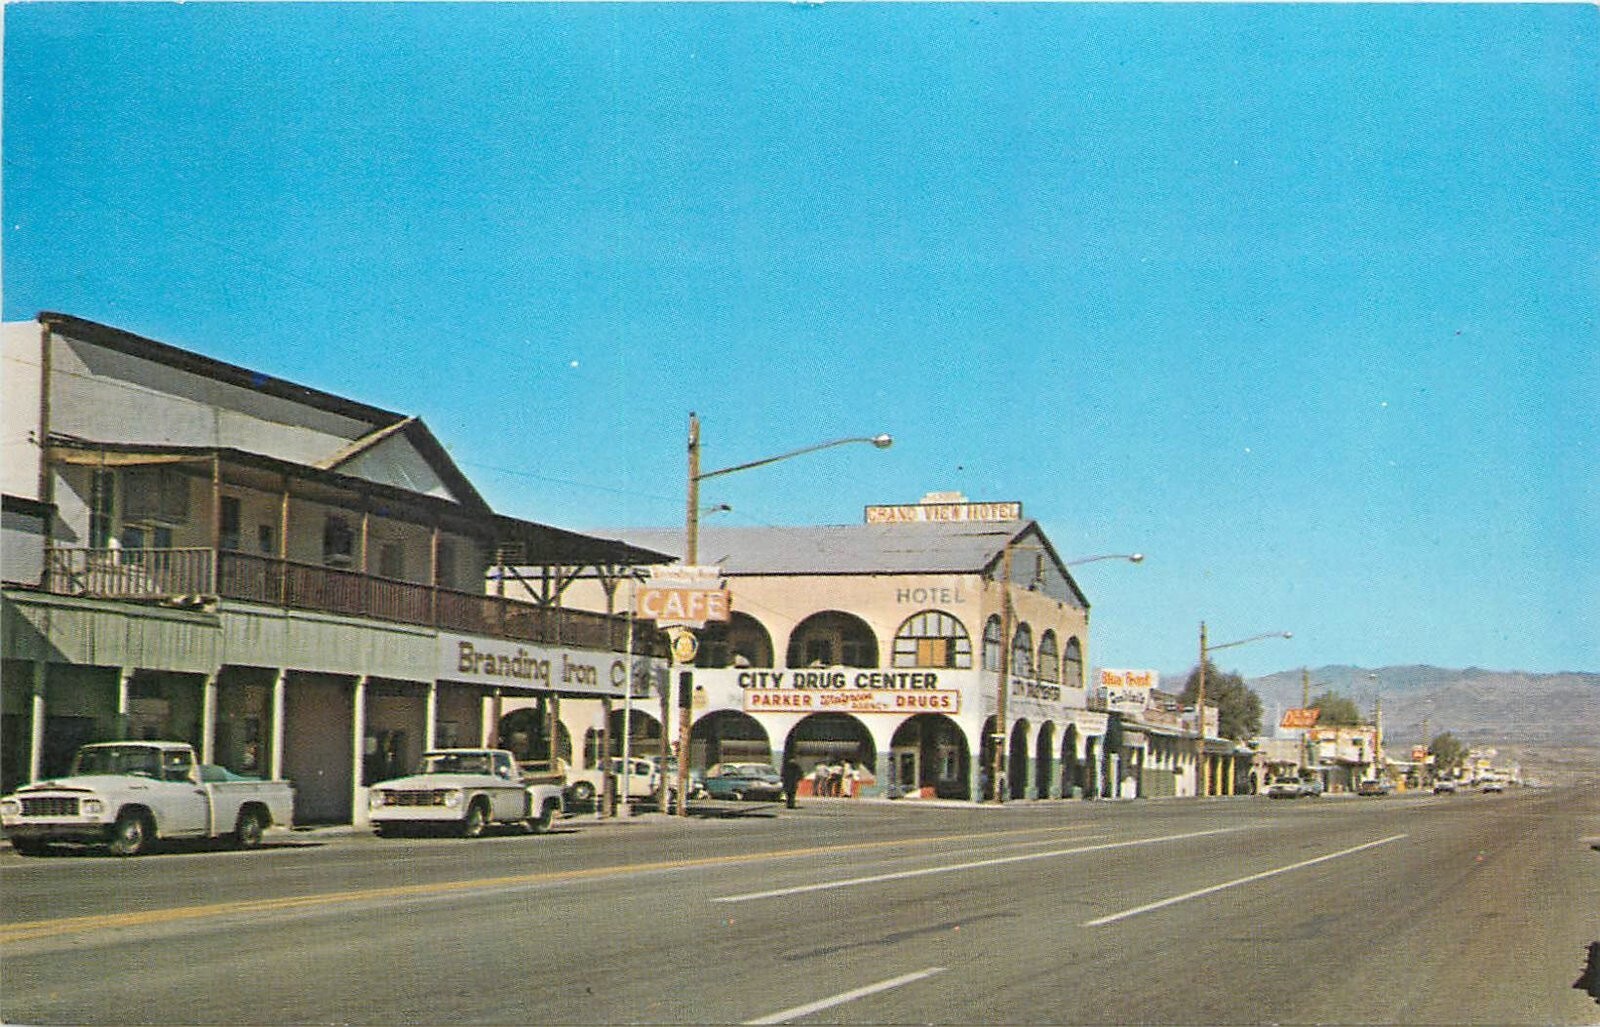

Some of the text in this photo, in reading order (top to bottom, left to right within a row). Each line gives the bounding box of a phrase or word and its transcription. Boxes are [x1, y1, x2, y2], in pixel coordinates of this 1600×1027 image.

[924, 505, 961, 520] VIEW
[966, 503, 1018, 519] HOTEL
[896, 587, 965, 604] HOTEL
[642, 591, 725, 619] CAFE
[457, 640, 551, 688] Branding
[562, 653, 598, 687] Iron
[738, 671, 938, 689] CITY DRUG CENTER
[751, 694, 812, 707] PARKER
[896, 695, 949, 708] DRUGS
